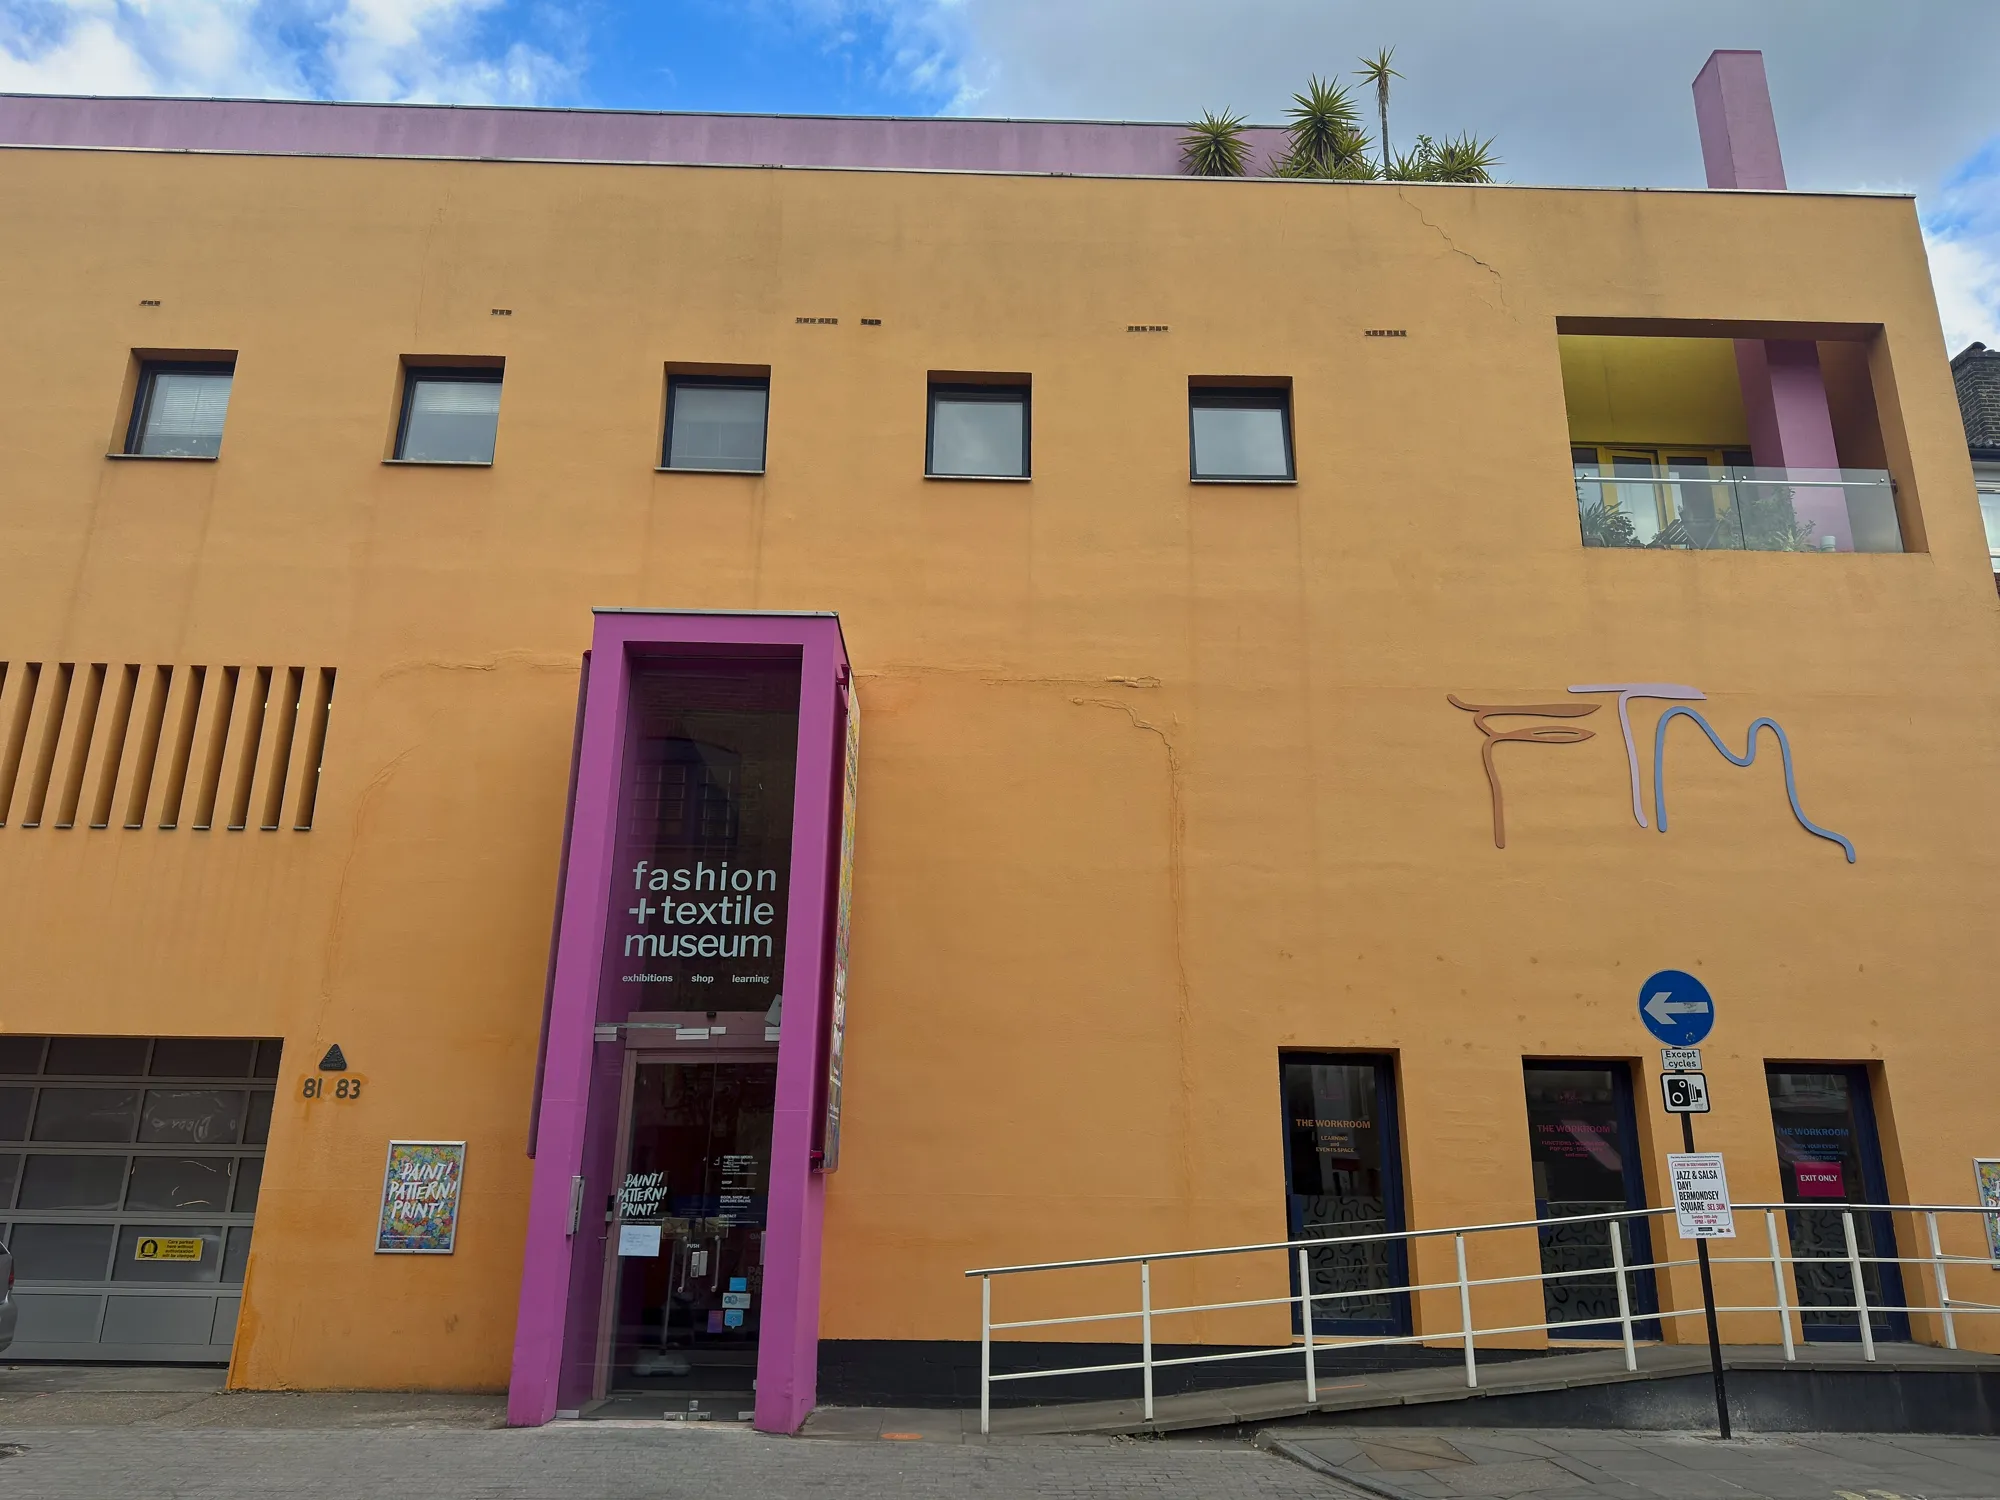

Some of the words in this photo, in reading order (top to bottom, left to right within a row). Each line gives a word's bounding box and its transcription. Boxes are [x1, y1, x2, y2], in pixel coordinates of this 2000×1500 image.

[632, 860, 777, 892] fashion
[624, 934, 773, 959] museum
[622, 973, 673, 983] exhibitions
[691, 974, 714, 984] shop
[732, 974, 770, 984] learning
[1665, 1050, 1696, 1059] Except
[1668, 1060, 1697, 1068] cycles
[303, 1077, 323, 1099] 81
[335, 1078, 361, 1100] 83
[1296, 1118, 1314, 1127] THE
[1315, 1120, 1371, 1129] WORKROOM
[1537, 1124, 1555, 1133] THE
[1555, 1125, 1611, 1133] WORKROOM
[1795, 1128, 1849, 1137] WORKROOM
[399, 1162, 454, 1180] PAINT!
[1676, 1170, 1691, 1180] JAZZ
[1692, 1170, 1697, 1180] &
[1698, 1169, 1718, 1180] SALSA
[623, 1171, 664, 1188] PAINT!
[1800, 1174, 1817, 1182] EXIT
[1818, 1174, 1838, 1182] ONLY
[388, 1180, 458, 1200] PATTERN!
[1677, 1180, 1692, 1191] DAY!
[616, 1186, 668, 1203] PATTERN!
[1679, 1190, 1719, 1201] BERMONDSEY
[391, 1200, 445, 1219] PRINT!
[619, 1202, 659, 1217] PRINT!
[1681, 1201, 1705, 1213] SQUARE
